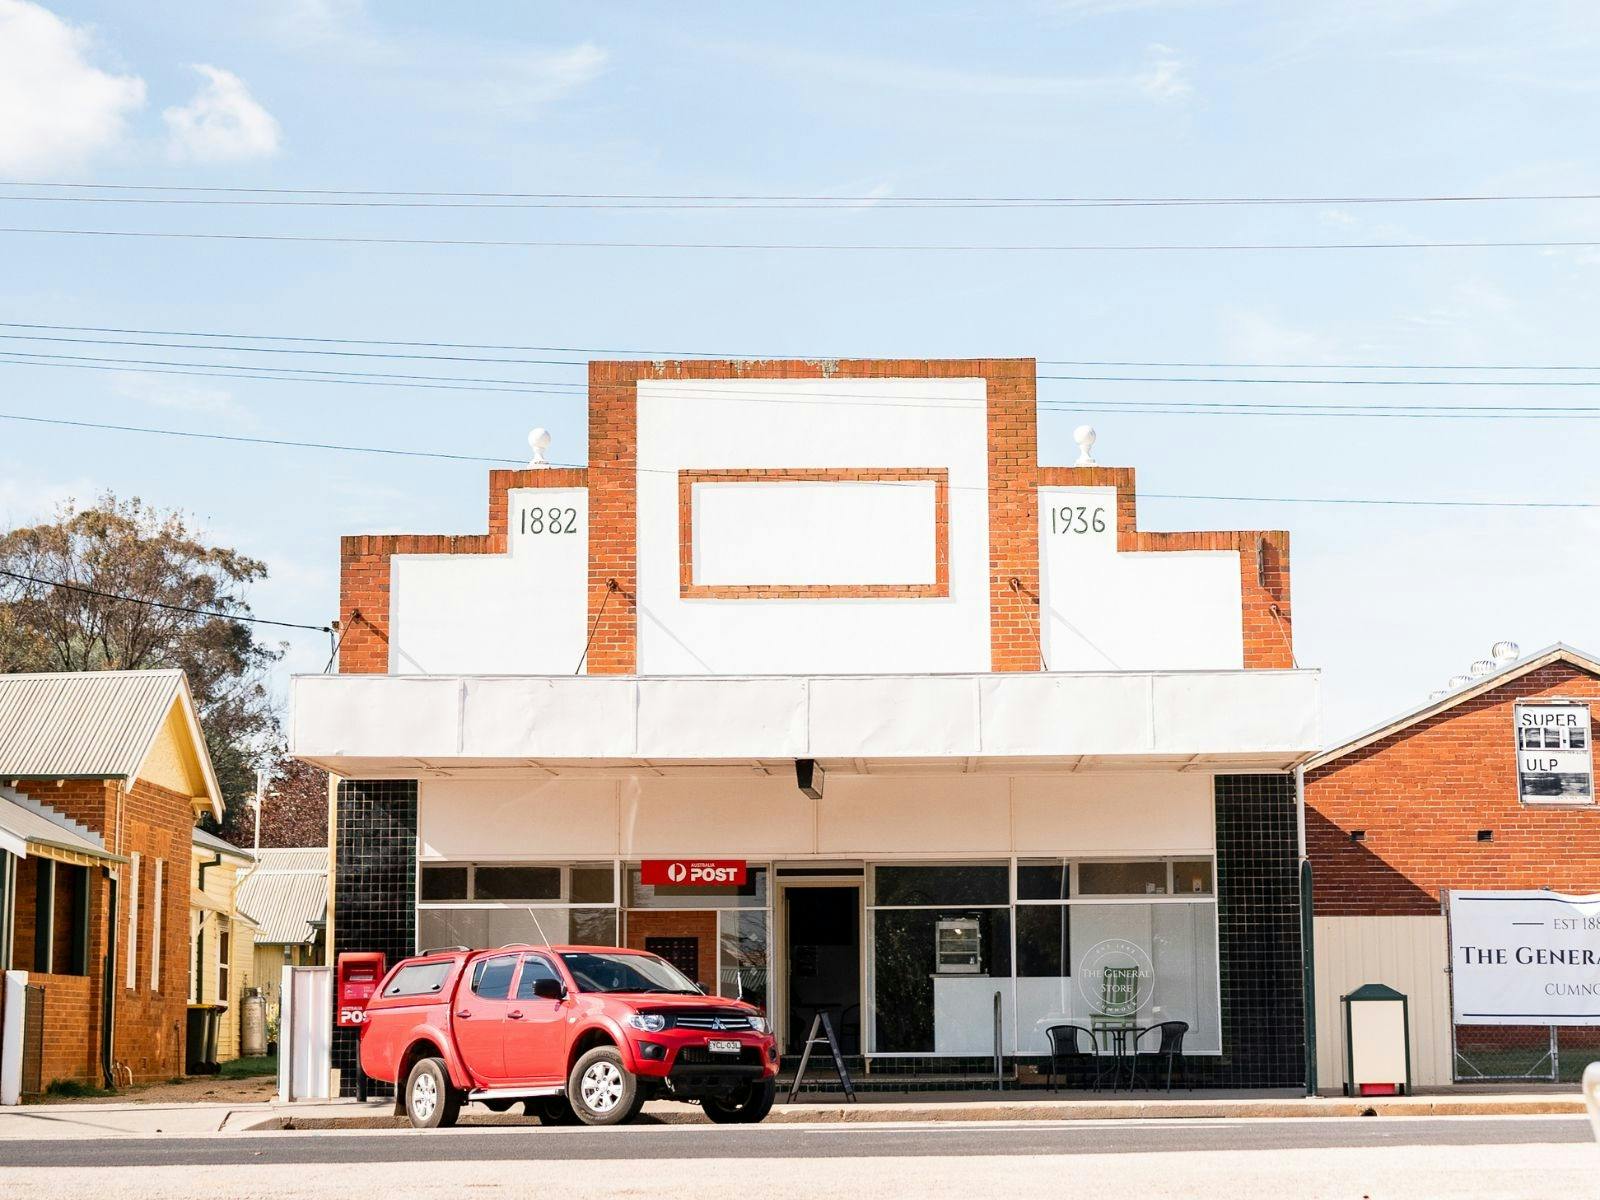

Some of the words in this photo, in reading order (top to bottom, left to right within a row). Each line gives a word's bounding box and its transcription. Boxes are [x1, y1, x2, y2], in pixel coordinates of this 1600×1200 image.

[521, 507, 577, 534] 1882
[1052, 506, 1105, 534] 1936
[1522, 713, 1577, 726] SUPER
[1526, 758, 1558, 771] ULP
[690, 867, 738, 882] POST
[1553, 918, 1578, 930] EST
[1460, 946, 1508, 965] THE
[1515, 946, 1600, 965] GENER
[1081, 968, 1102, 978] THE
[1104, 968, 1150, 978] GENERAL
[1101, 983, 1134, 993] STORE
[341, 1010, 369, 1024] POS
